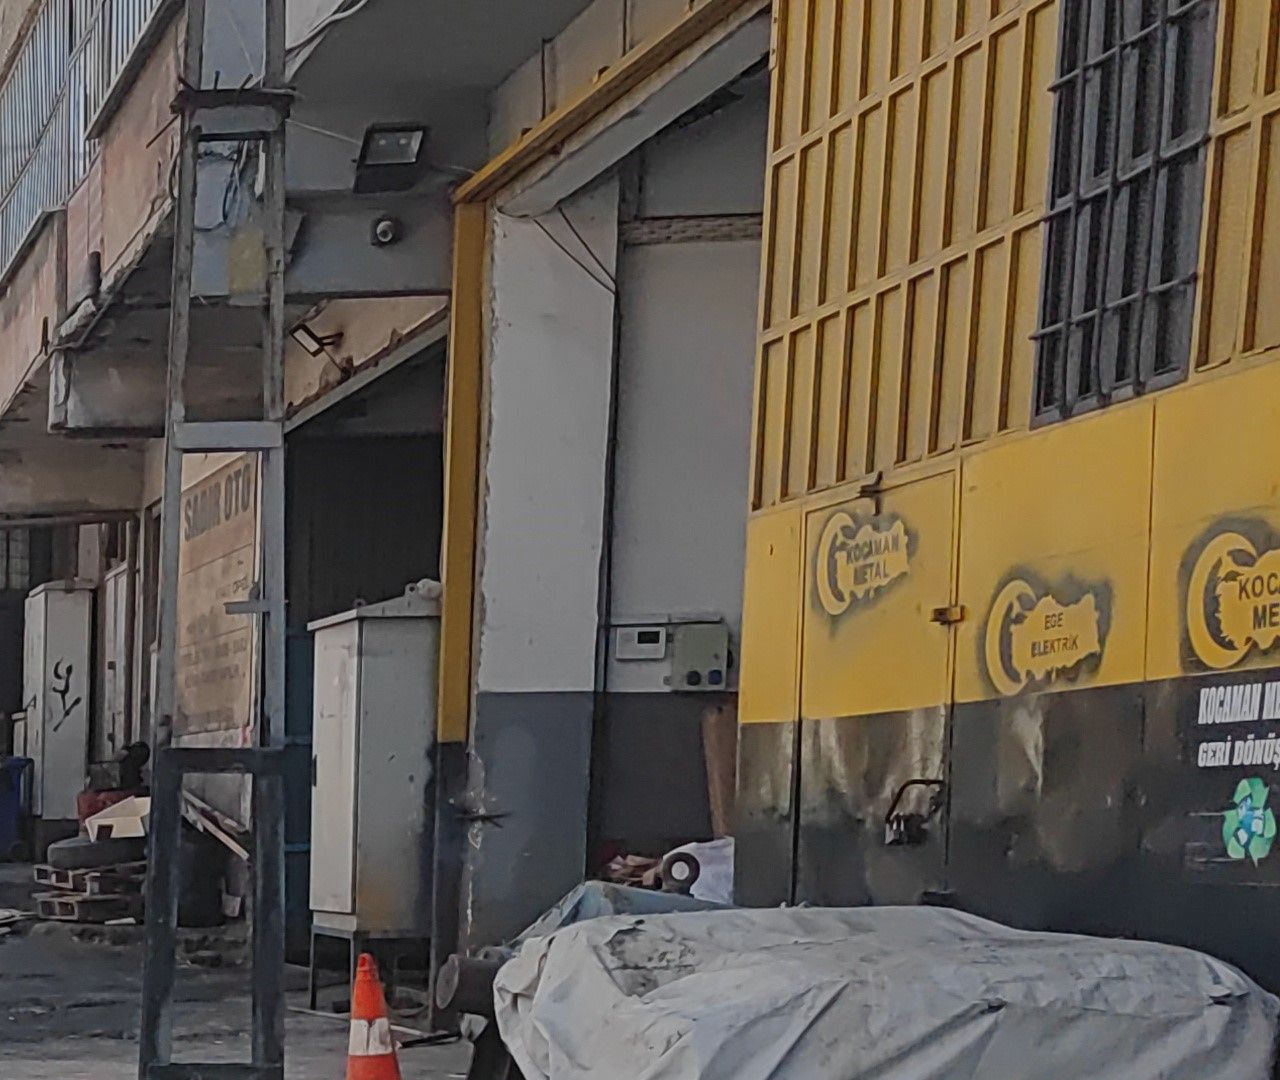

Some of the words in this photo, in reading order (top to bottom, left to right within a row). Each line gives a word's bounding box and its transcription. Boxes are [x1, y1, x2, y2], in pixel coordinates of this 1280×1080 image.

[224, 463, 251, 521] OTO
[1238, 572, 1280, 601] KOC
[1044, 612, 1064, 630] EGE
[1198, 683, 1263, 725] KOCAMAN
[1198, 735, 1232, 767] GERİ
